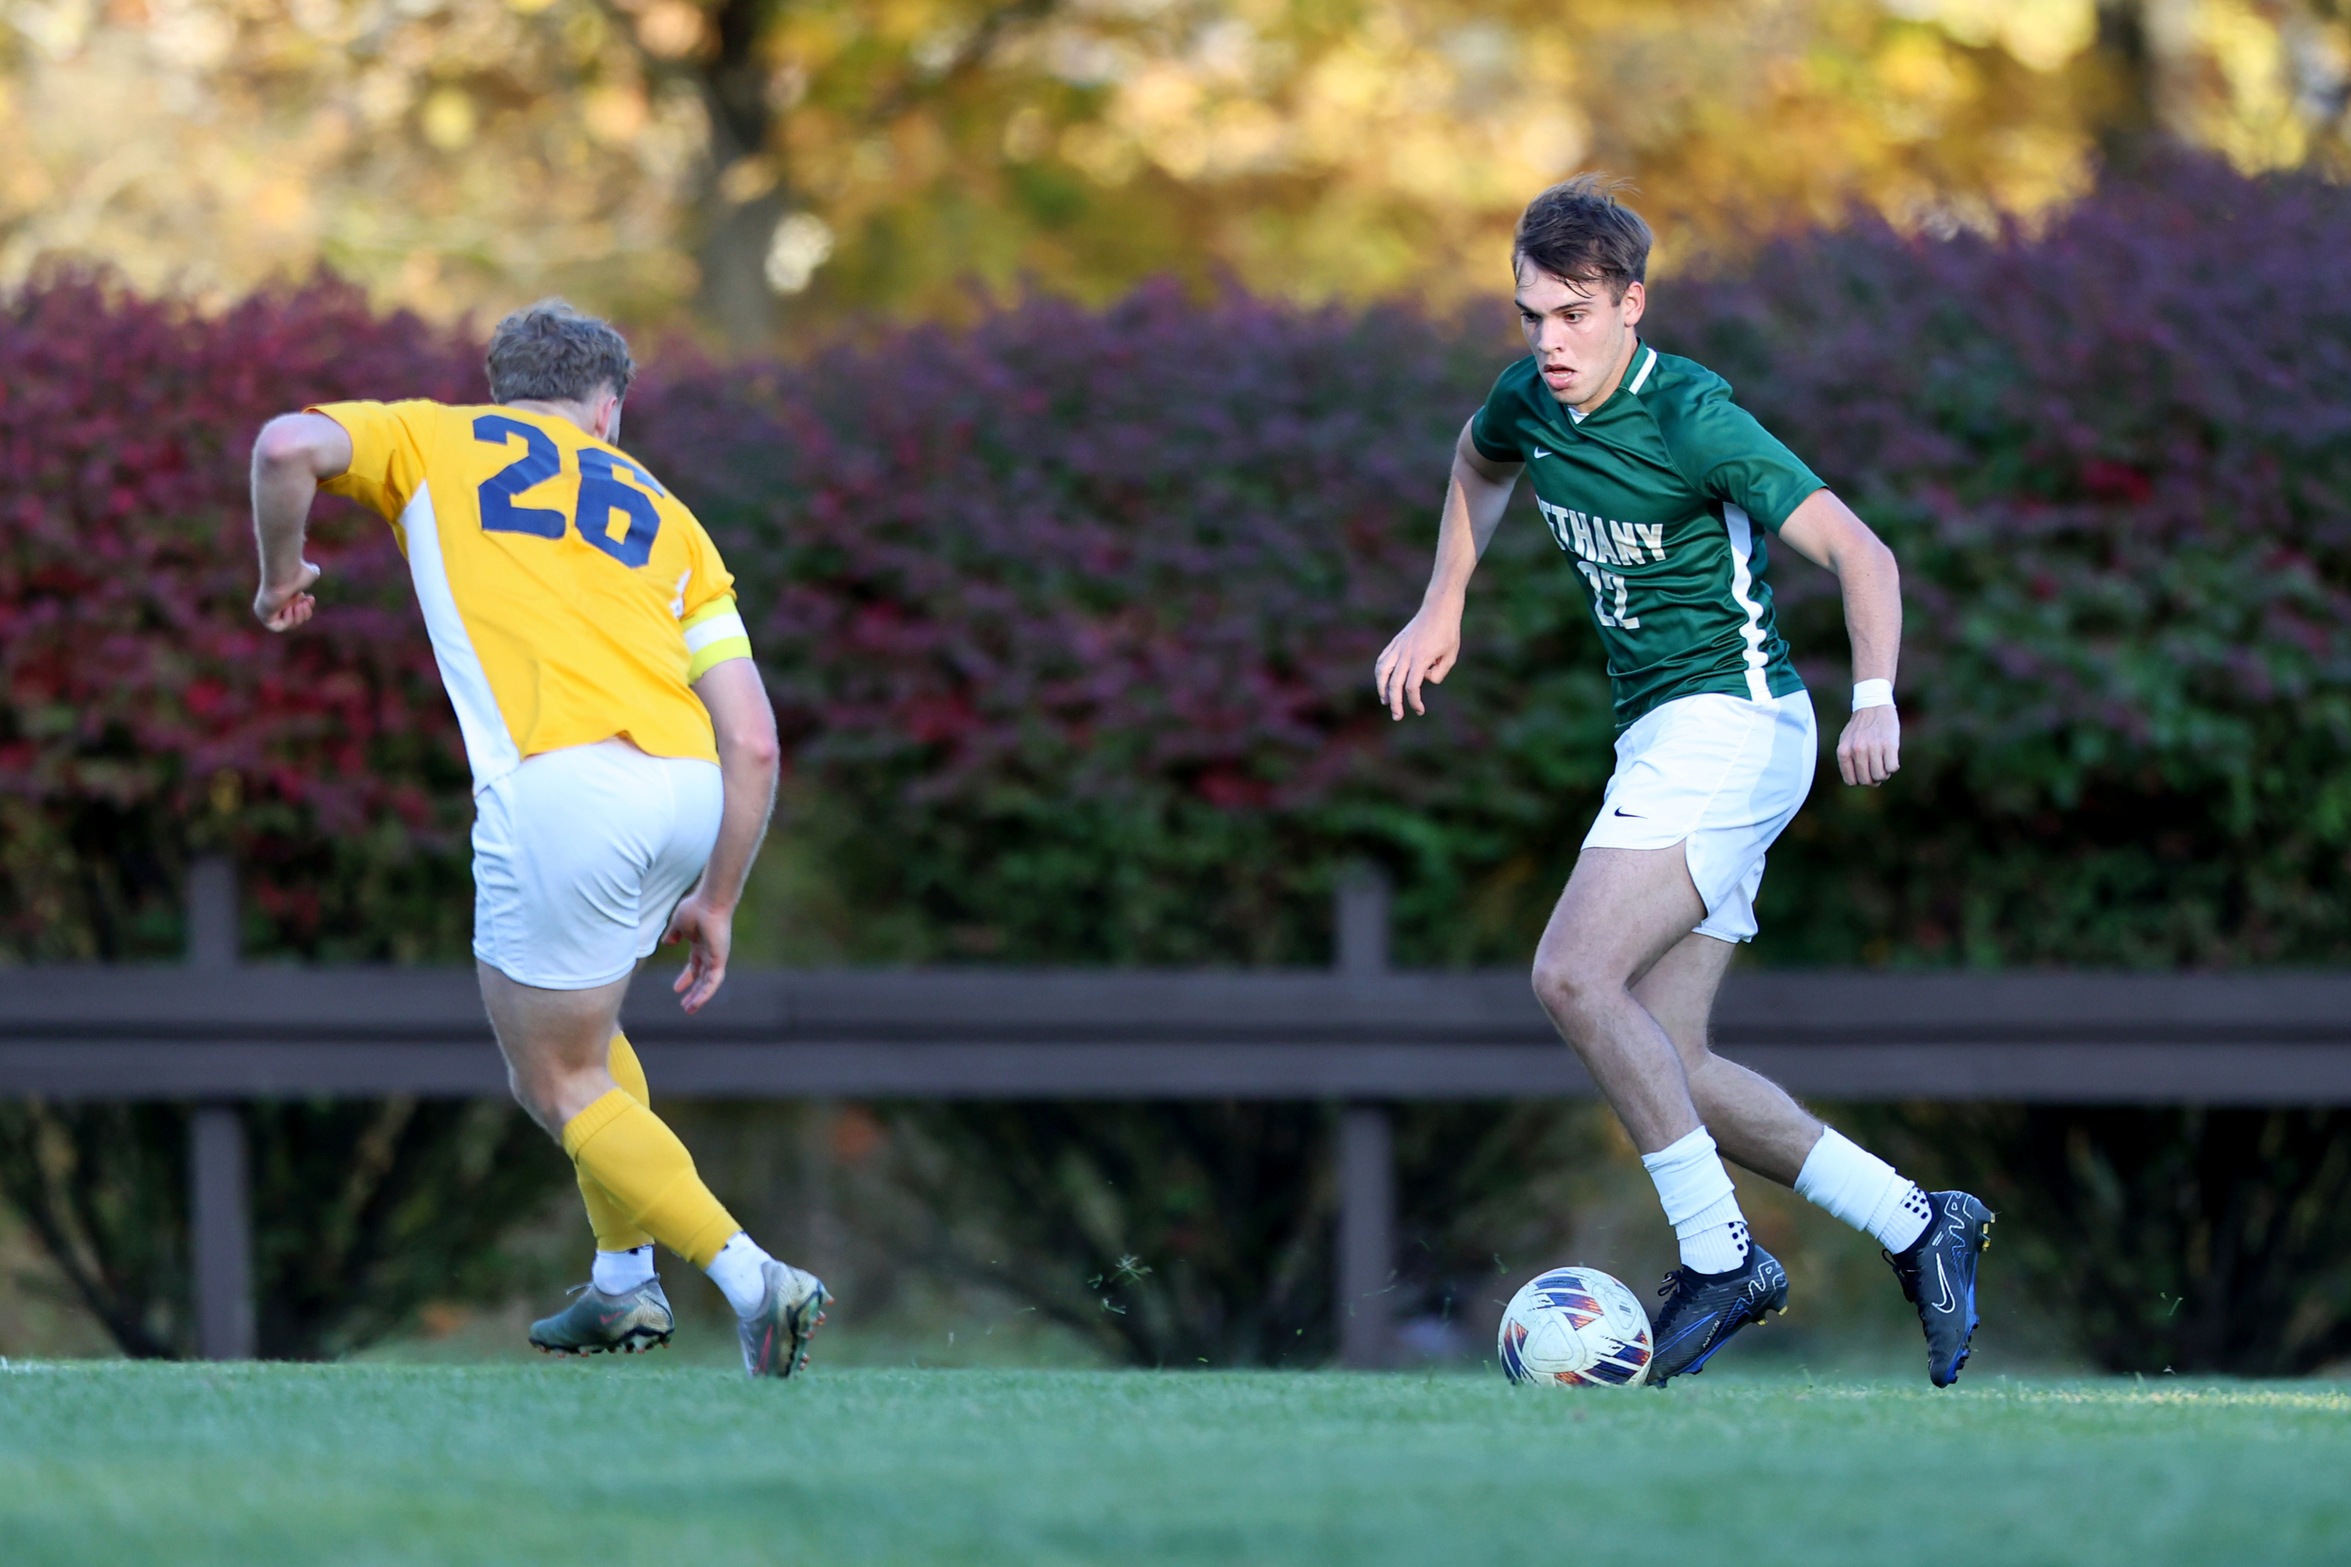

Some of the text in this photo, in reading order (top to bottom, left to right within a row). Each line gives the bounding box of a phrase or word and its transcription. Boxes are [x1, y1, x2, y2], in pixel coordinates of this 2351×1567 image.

[472, 414, 664, 570] 26
[1535, 493, 1667, 566] ETHANY
[1576, 561, 1640, 630] 22
